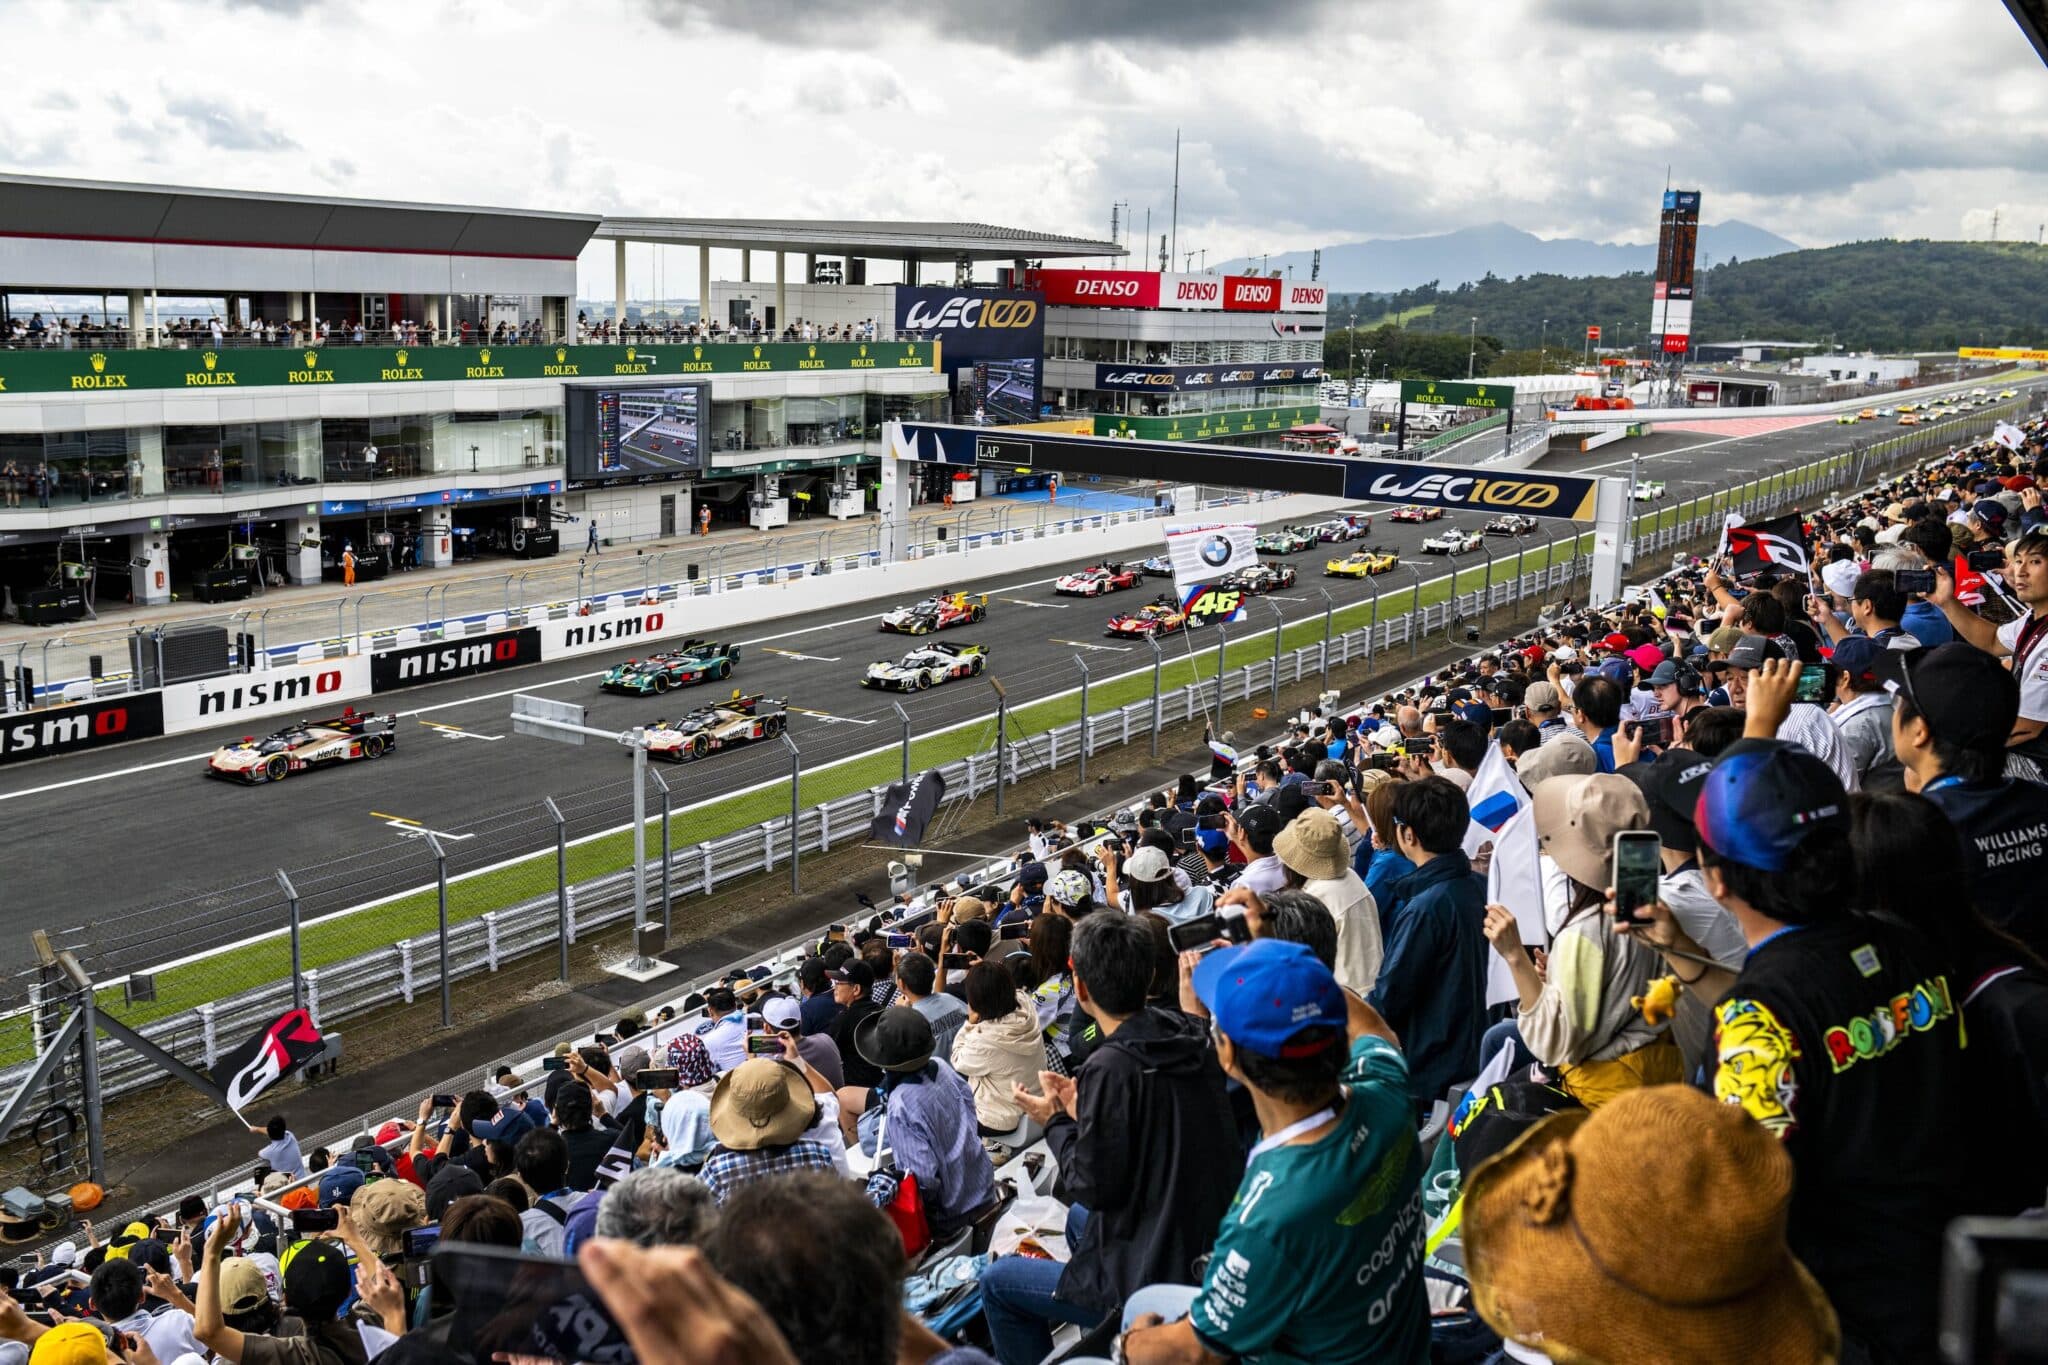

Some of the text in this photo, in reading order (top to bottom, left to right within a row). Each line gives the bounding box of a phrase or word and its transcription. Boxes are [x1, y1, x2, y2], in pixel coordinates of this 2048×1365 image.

[1075, 279, 1139, 297] DENSO
[1177, 281, 1218, 301] DENSO
[1235, 284, 1272, 303] DENSO
[1291, 287, 1324, 304] DENSO
[905, 296, 1037, 329] WEC100
[683, 361, 713, 372] ROLEX
[743, 361, 771, 370] ROLEX
[799, 360, 825, 369] ROLEX
[851, 358, 875, 367] ROLEX
[899, 358, 922, 366] ROLEX
[382, 368, 423, 380] ROLEX
[466, 367, 504, 378] ROLEX
[543, 365, 579, 376] ROLEX
[615, 364, 647, 374] ROLEX
[71, 375, 128, 389] ROLEX
[186, 372, 236, 385] ROLEX
[288, 370, 334, 382] ROLEX
[1104, 373, 1176, 386] WEC100
[1416, 394, 1446, 404] ROLEX
[1466, 397, 1496, 408] ROLEX
[979, 445, 1000, 458] LAP
[1369, 473, 1560, 509] WEC100
[1191, 591, 1240, 616] 46
[565, 613, 664, 648] nismo
[399, 638, 518, 680] nismo
[199, 670, 342, 716] nismo
[727, 728, 749, 740] Hertz
[316, 746, 344, 760] Hertz
[1974, 823, 2048, 853] WILLIAMS
[1986, 842, 2043, 868] RACING
